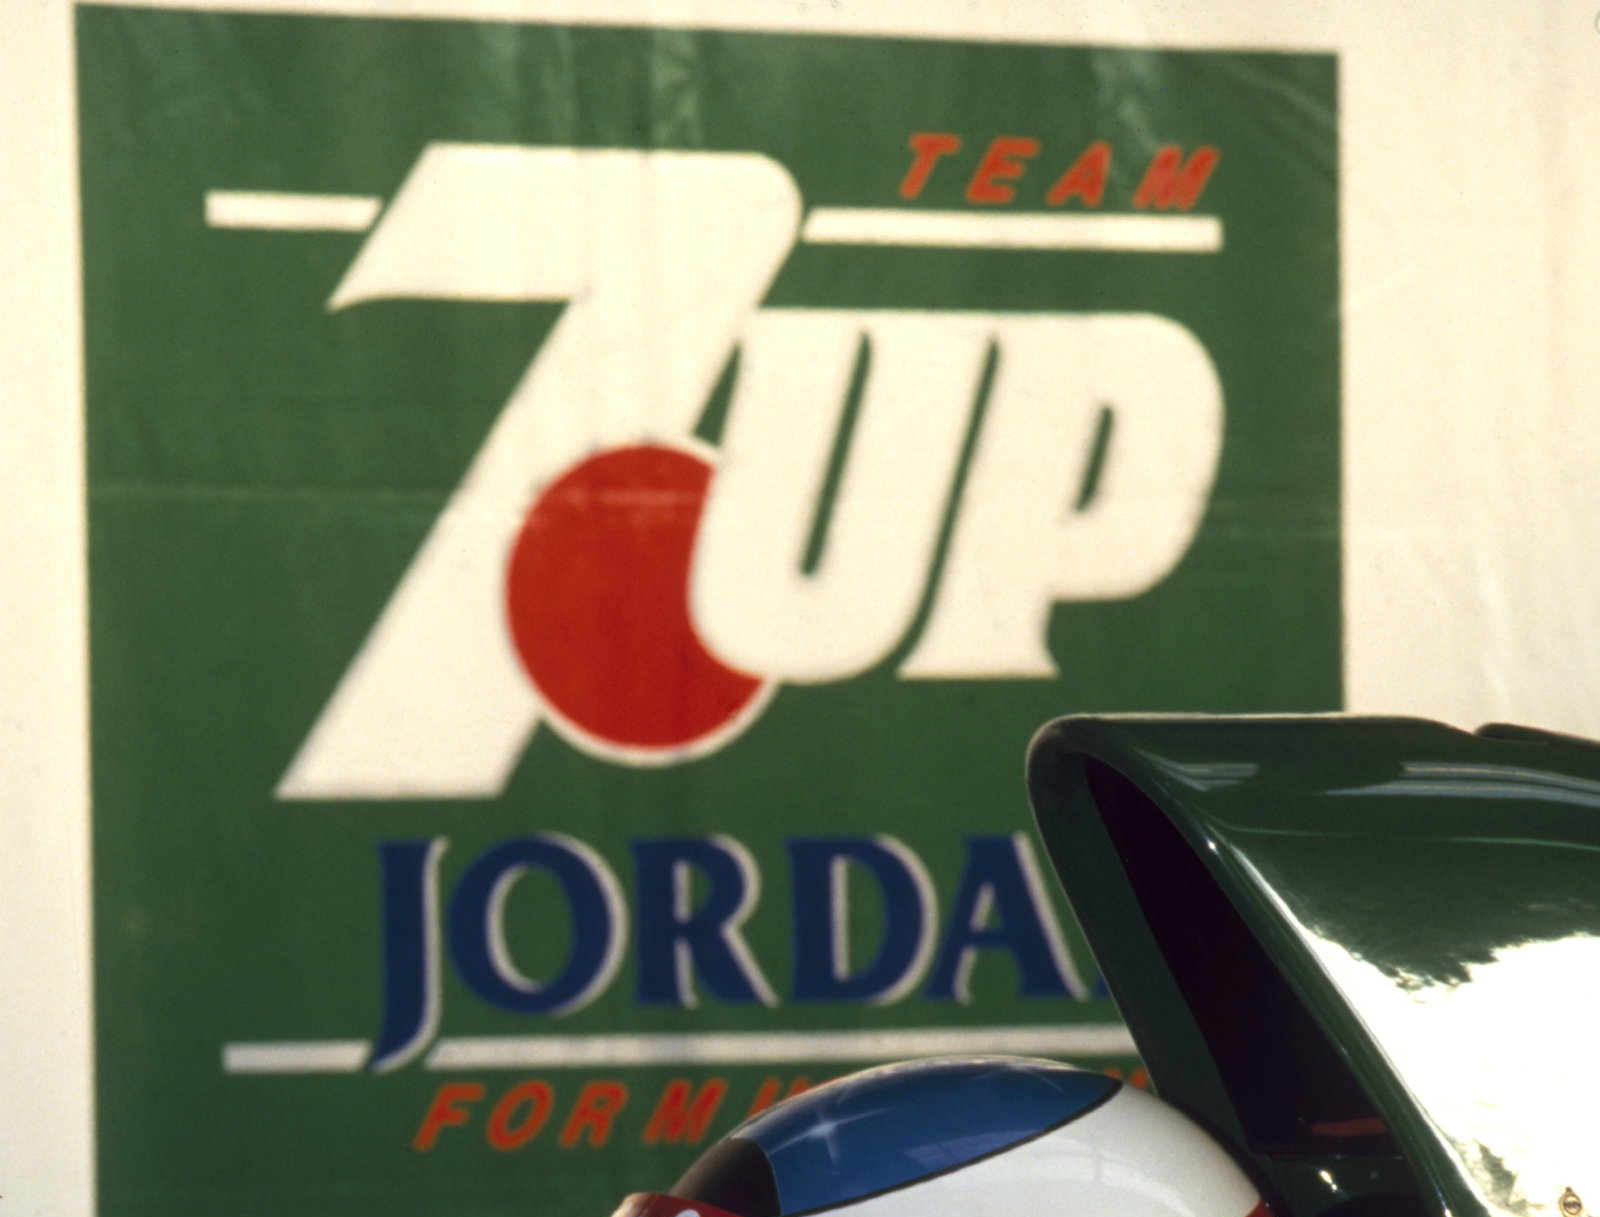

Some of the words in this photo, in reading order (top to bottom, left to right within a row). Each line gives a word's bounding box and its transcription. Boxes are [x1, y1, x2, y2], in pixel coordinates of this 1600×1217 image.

[900, 134, 1222, 210] TEAM
[276, 143, 1224, 798] 7UP
[368, 832, 1108, 1074] JORDA
